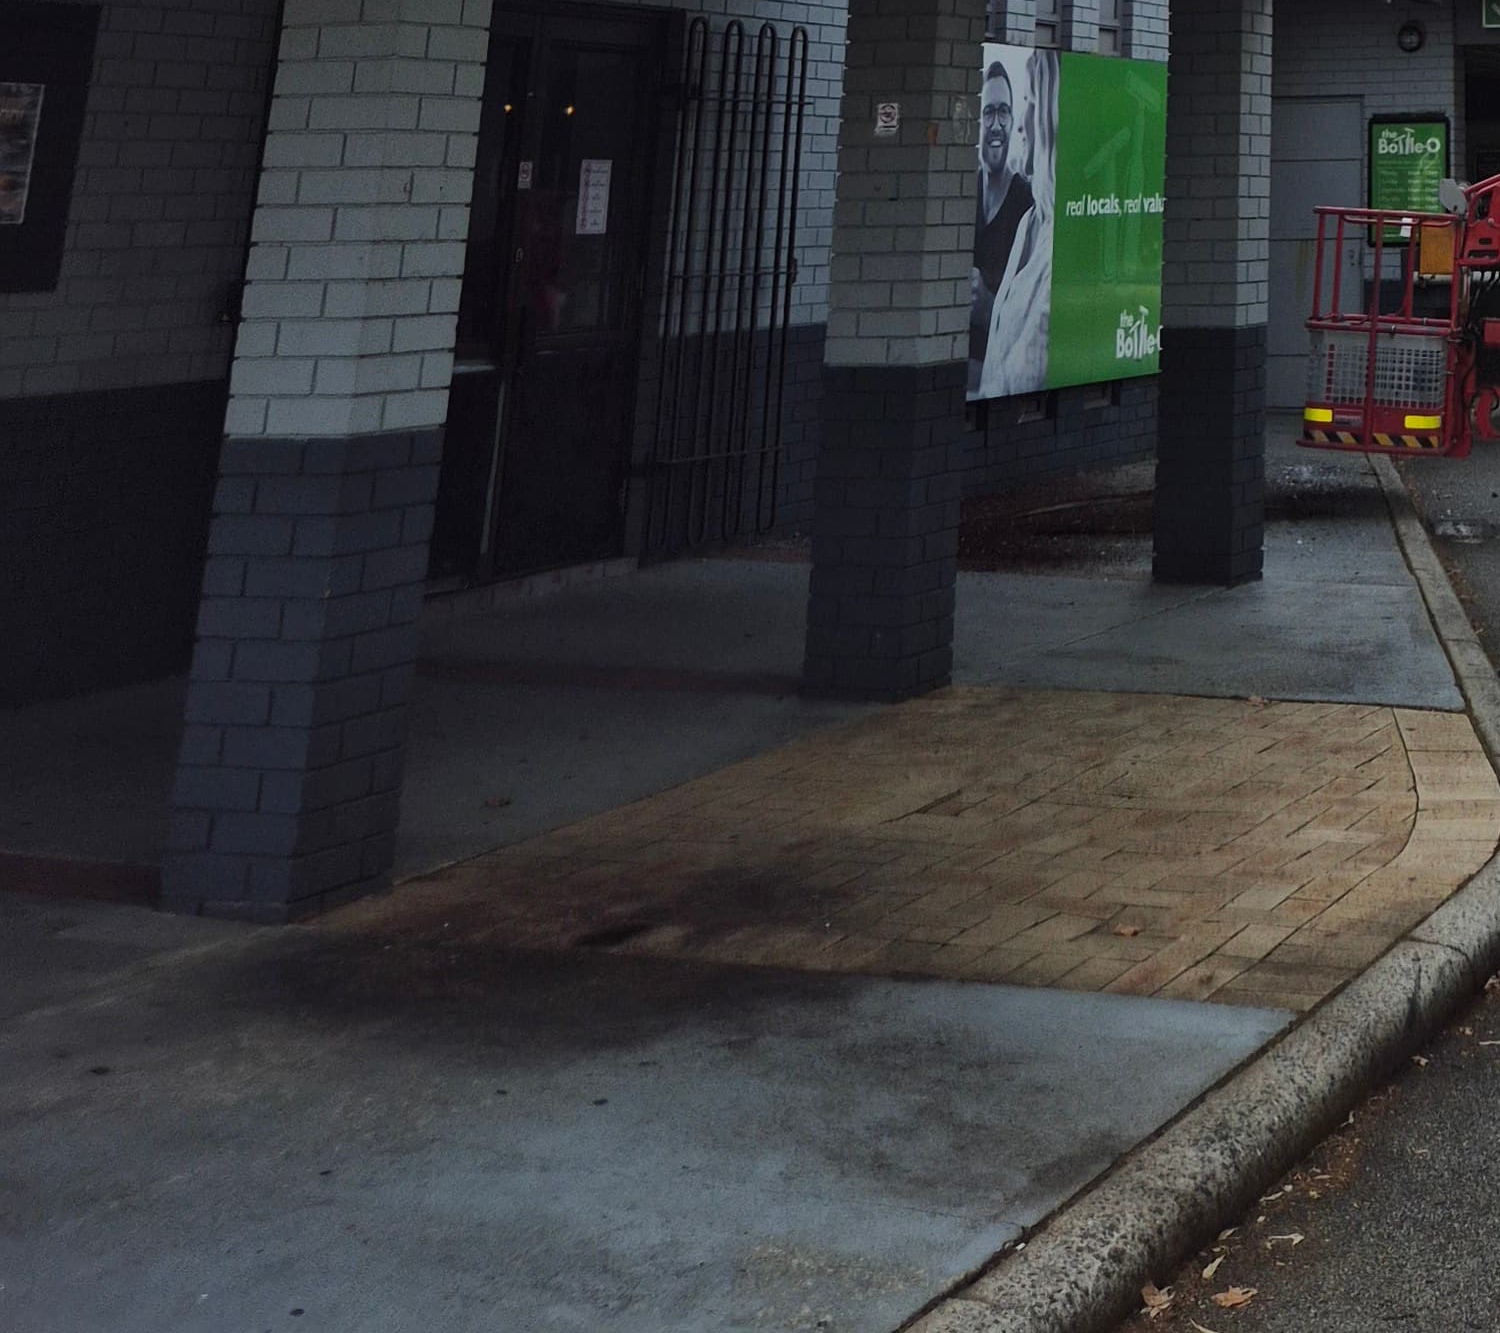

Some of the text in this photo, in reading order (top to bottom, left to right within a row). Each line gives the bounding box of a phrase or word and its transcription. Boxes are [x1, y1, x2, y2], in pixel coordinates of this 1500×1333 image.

[1381, 128, 1398, 139] the
[1066, 192, 1165, 217] real locals, real valu
[1119, 309, 1134, 328] the
